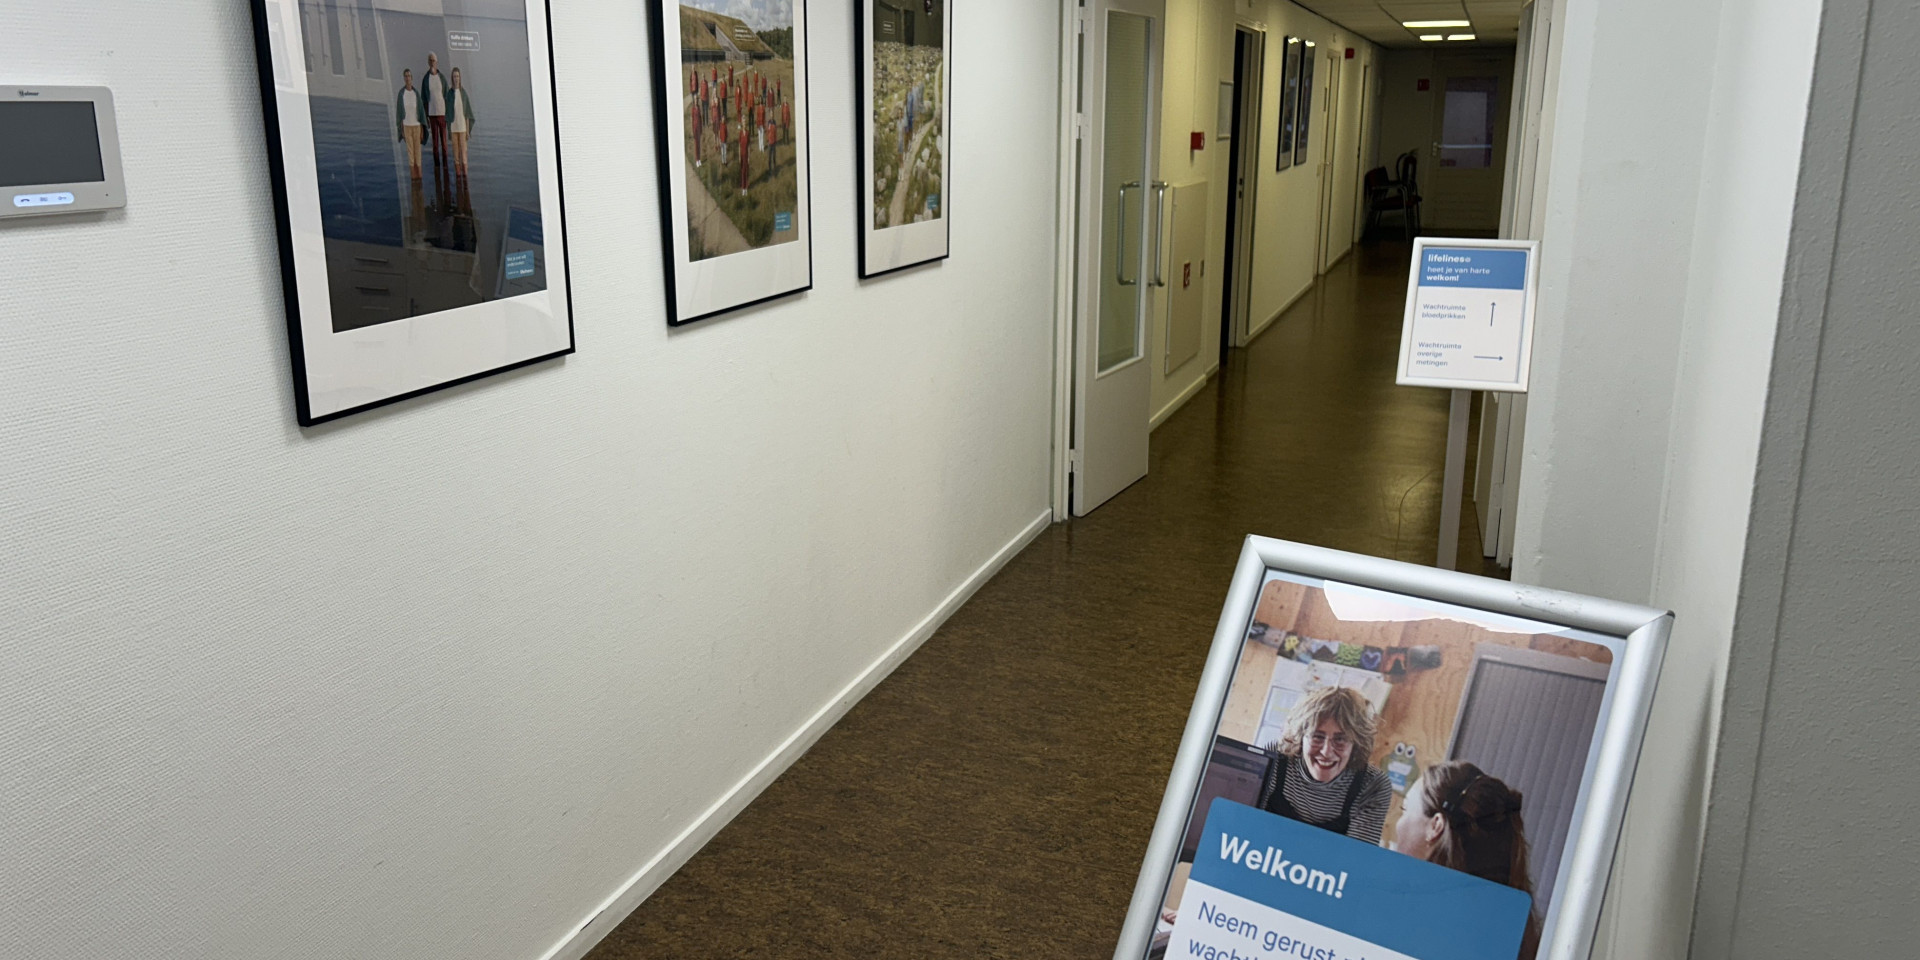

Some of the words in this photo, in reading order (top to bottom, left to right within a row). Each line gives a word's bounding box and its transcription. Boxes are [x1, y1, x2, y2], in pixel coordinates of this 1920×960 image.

[1428, 254, 1465, 263] lifelines
[1470, 267, 1491, 275] harte
[1426, 274, 1460, 282] welkom!
[1423, 303, 1466, 311] Wachtruimte
[1421, 312, 1466, 320] bloedprikken
[1418, 341, 1462, 350] Wachtruimte
[1416, 351, 1443, 359] overige
[1415, 359, 1448, 367] metingen
[1220, 832, 1349, 899] Welkom!
[1198, 900, 1258, 940] Neem
[1262, 930, 1336, 960] gerust
